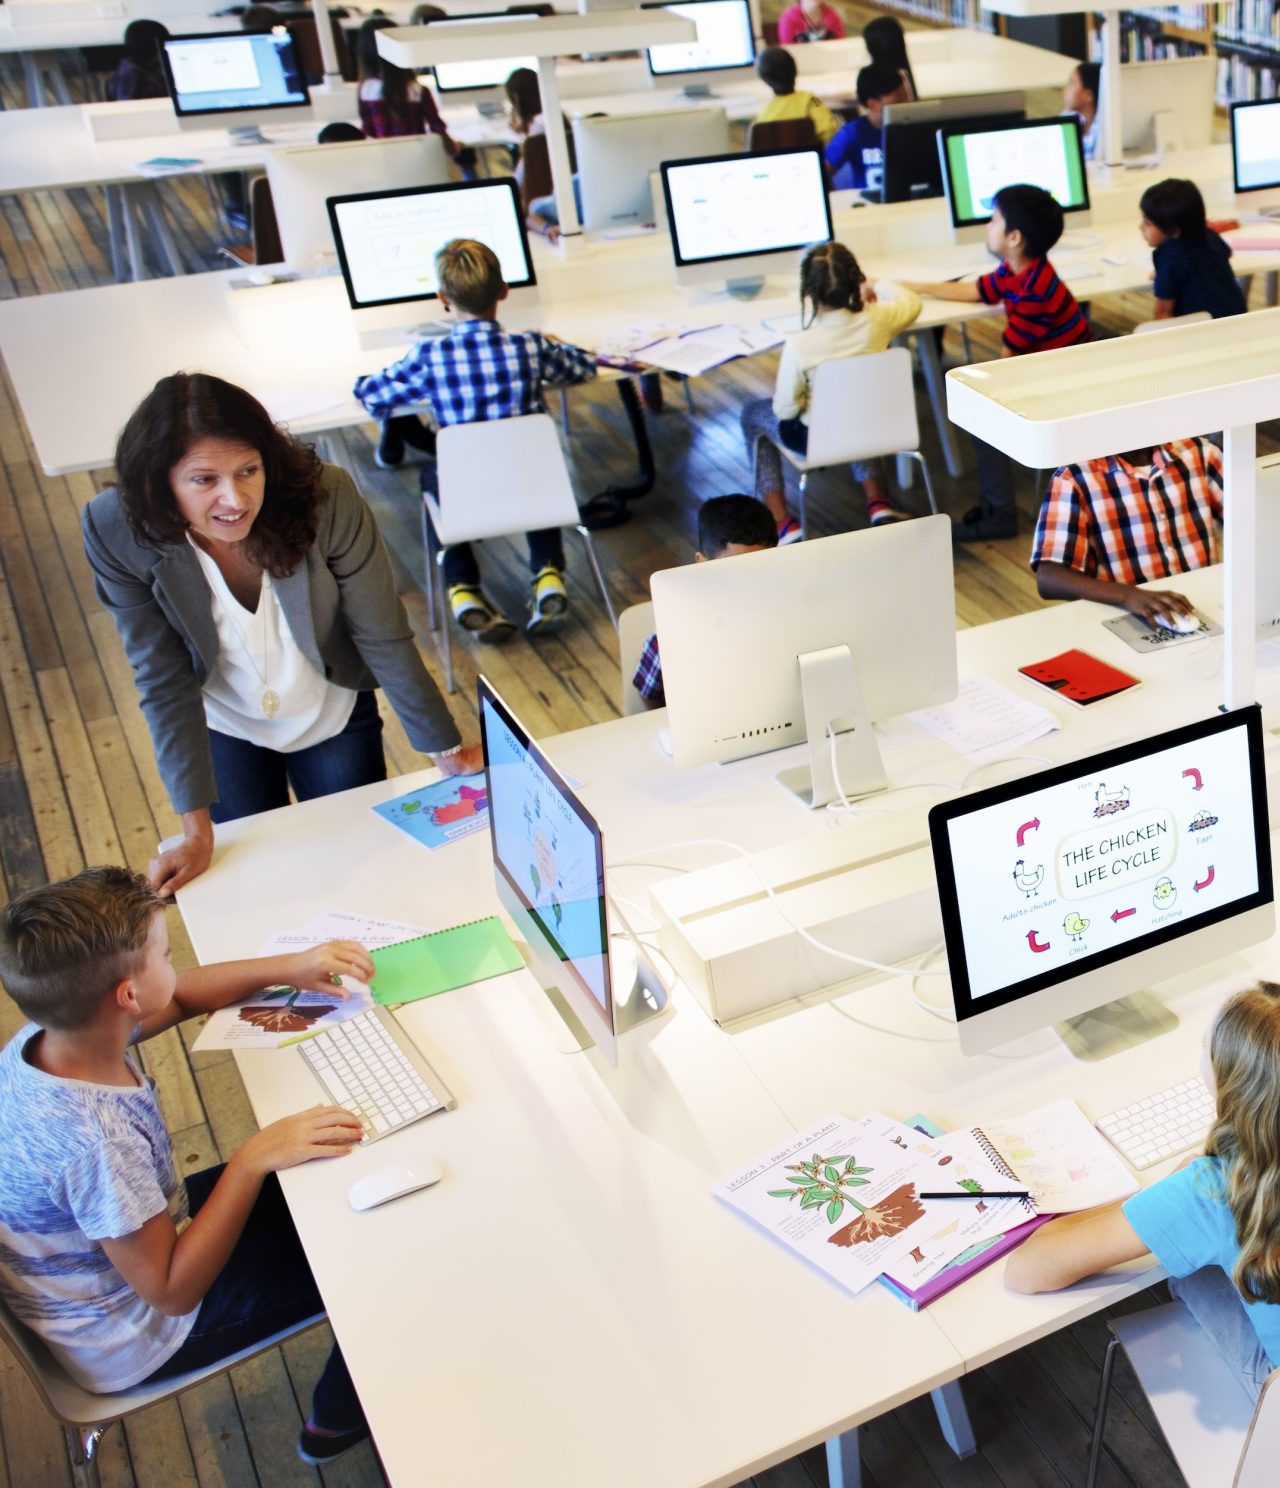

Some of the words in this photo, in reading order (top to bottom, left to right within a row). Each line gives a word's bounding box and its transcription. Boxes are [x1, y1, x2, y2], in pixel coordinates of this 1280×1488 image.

[1062, 845, 1094, 868] THE
[1099, 819, 1168, 856] CHICKEN
[1074, 865, 1108, 889] LIFE
[1111, 846, 1161, 875] CYCLE
[726, 1168, 759, 1190] LESSON
[772, 1148, 792, 1163] PART
[793, 1140, 804, 1151] OF
[813, 1121, 838, 1138] PLANT
